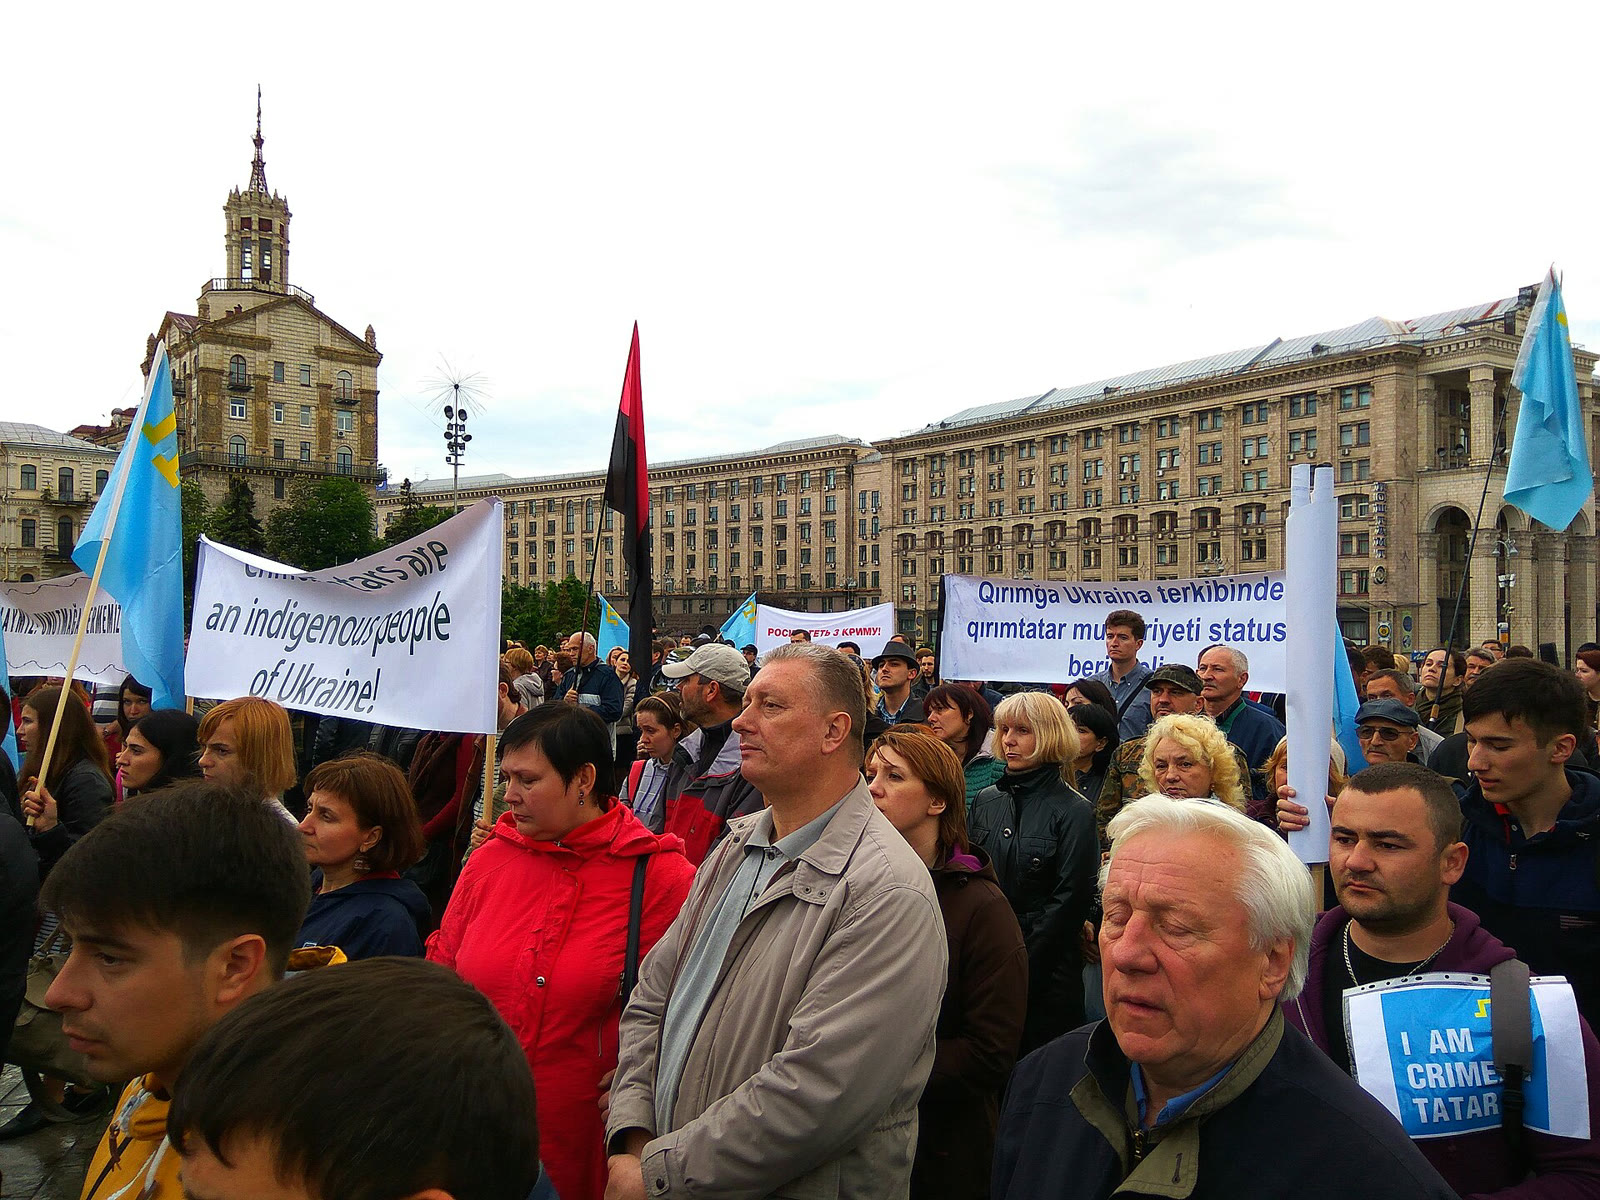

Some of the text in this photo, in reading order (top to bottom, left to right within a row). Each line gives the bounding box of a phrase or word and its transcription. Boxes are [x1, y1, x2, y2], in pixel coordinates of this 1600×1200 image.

[395, 541, 449, 578] are
[1062, 586, 1153, 604] Ukraina
[1157, 576, 1284, 603] terkibinde
[86, 603, 122, 634] ERMEMIZ
[205, 590, 450, 657] an indigenous people
[842, 627, 881, 637] КРИМУ!
[967, 616, 1287, 648] qırımtatar muriyeti status
[249, 659, 381, 714] of Ukraine!
[1400, 1027, 1474, 1056] I AM
[1407, 1060, 1531, 1090] CRIME
[1412, 1092, 1499, 1124] TATAR
